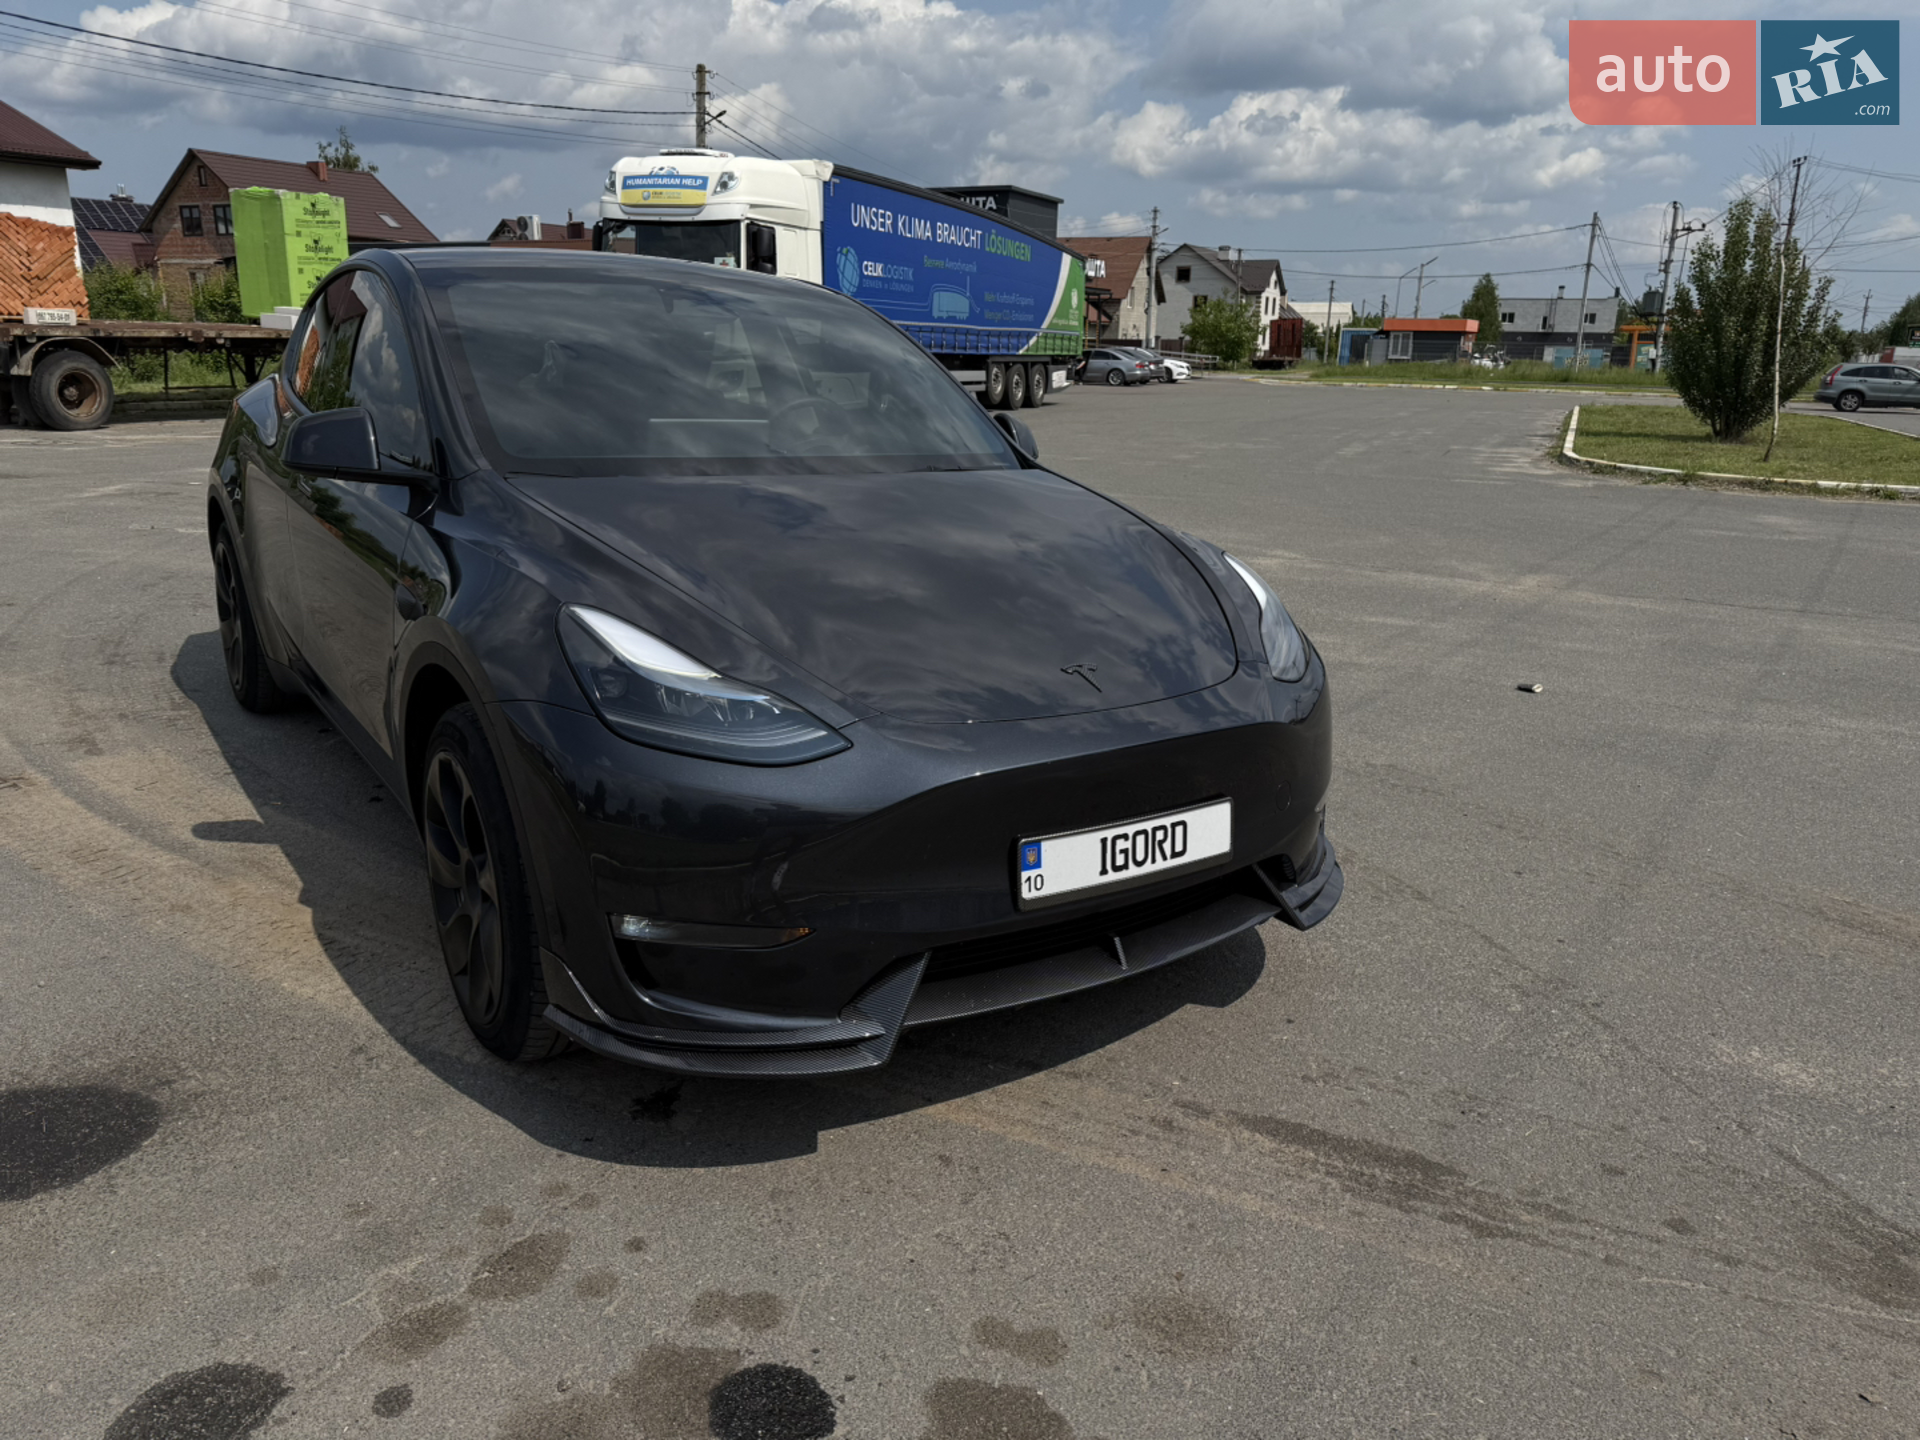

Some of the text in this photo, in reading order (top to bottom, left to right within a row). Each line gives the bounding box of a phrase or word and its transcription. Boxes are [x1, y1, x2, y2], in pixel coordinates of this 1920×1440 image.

[626, 177, 704, 186] HUMANITARIAN HELP
[850, 202, 1032, 262] UNSER KLIMA BRAUCHT LÖSUNGEN
[1099, 820, 1188, 876] IGORD
[1024, 874, 1044, 893] 10
